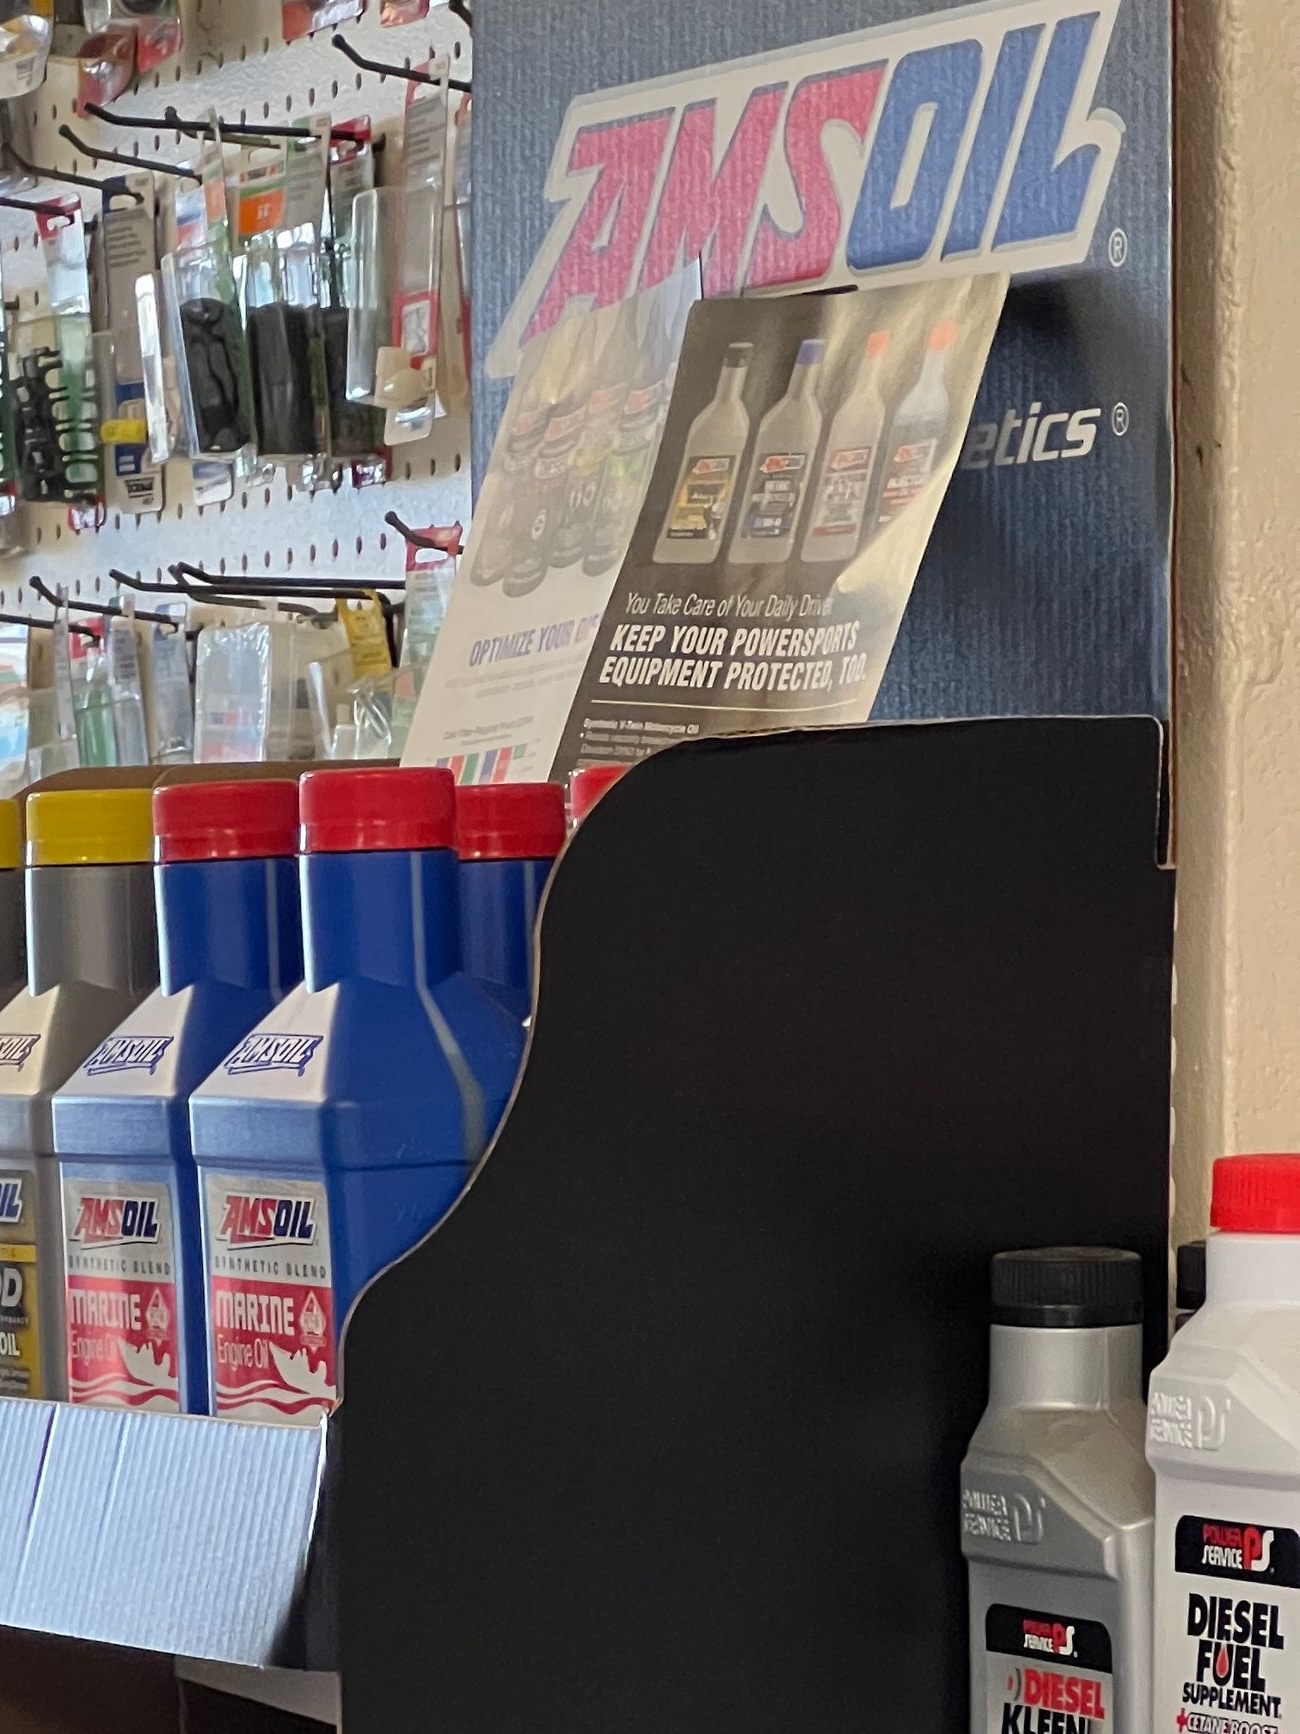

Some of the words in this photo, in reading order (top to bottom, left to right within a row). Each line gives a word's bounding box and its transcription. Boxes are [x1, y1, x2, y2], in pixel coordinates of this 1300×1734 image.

[518, 11, 1102, 346] AMSOIL
[960, 402, 1101, 470] etics
[625, 593, 648, 614] You
[655, 594, 681, 615] Take
[684, 594, 714, 616] Care
[717, 594, 731, 617] of
[736, 596, 762, 617] Your
[765, 596, 796, 622] Daily
[469, 629, 535, 667] OPTIMIZE
[537, 620, 575, 652] YOUR
[610, 624, 666, 652] KEEP
[671, 625, 729, 656] YOUR
[730, 620, 860, 657] POWERSPORTS
[600, 656, 722, 689] EQUIPMENT
[723, 662, 833, 691] PROTECTED,
[839, 653, 868, 684] TOO.
[84, 1036, 174, 1077] AMSOIL
[224, 1035, 324, 1077] AMSOIL
[70, 1196, 161, 1250] AMSOIL
[216, 1195, 317, 1250] AMSOIL
[215, 1256, 279, 1275] SYNTHETIC
[70, 1291, 142, 1330] MARINE
[216, 1291, 294, 1336] MARINE
[217, 1335, 254, 1369] Engine
[256, 1339, 270, 1368] Oil
[1203, 1524, 1243, 1547] POWER
[1202, 1545, 1243, 1569] SERVICE
[1187, 1593, 1284, 1649] DIESEL
[1196, 1639, 1266, 1692] FUEL
[1024, 1668, 1105, 1720] DIESEL
[1182, 1682, 1281, 1719] SUPPLEMENT
